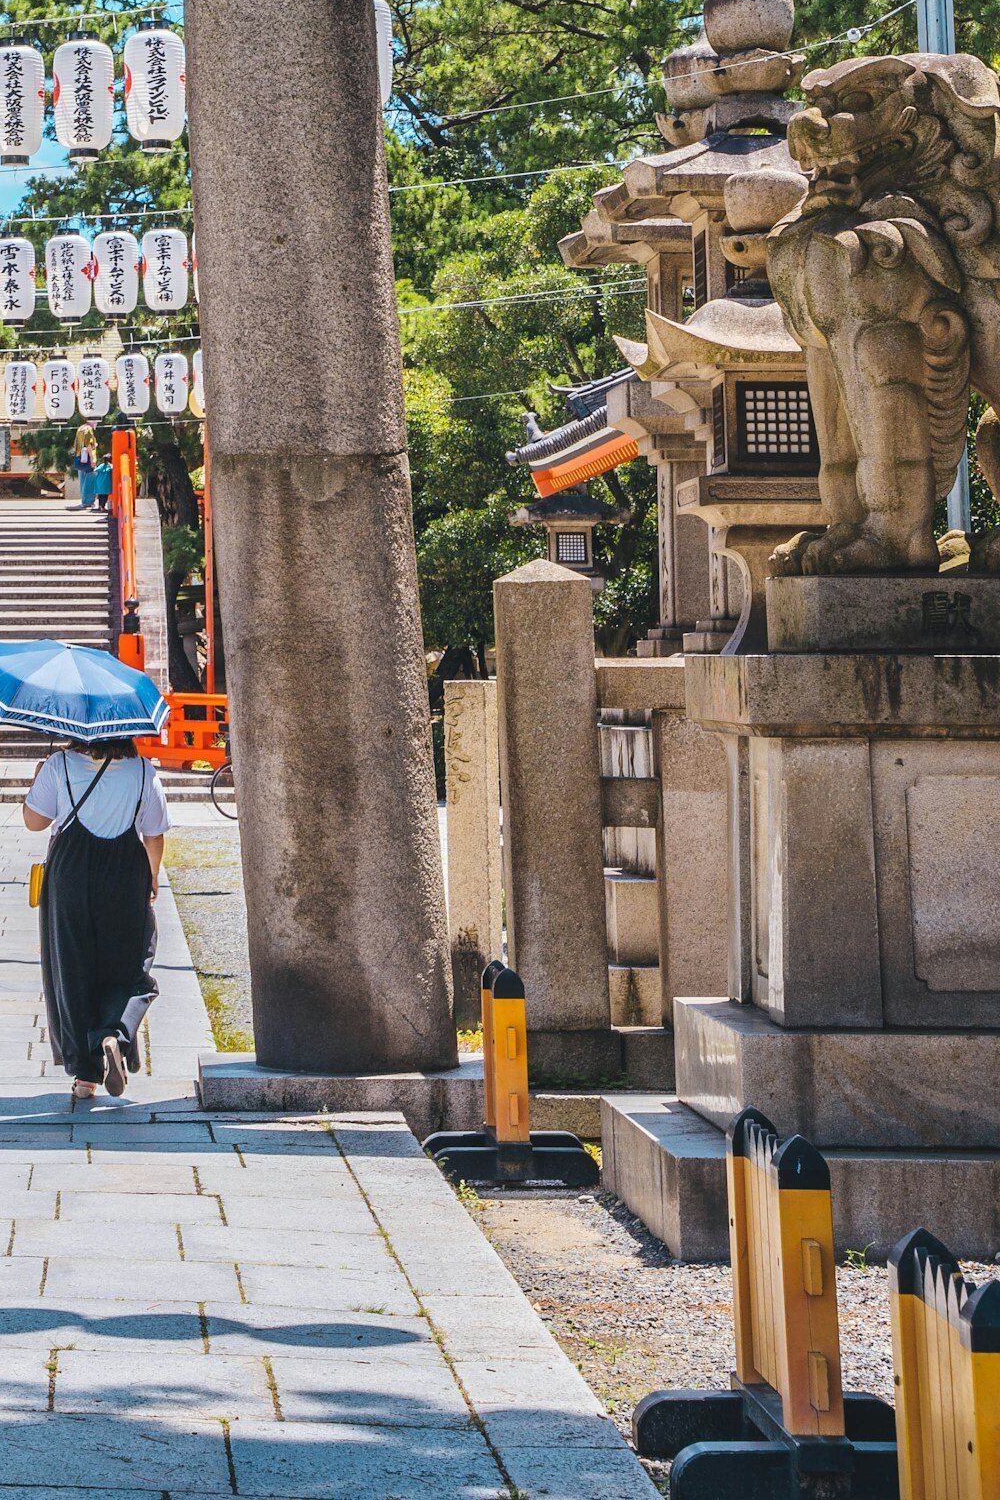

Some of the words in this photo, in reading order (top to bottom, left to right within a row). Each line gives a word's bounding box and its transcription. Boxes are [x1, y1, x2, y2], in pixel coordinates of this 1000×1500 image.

[3, 51, 26, 147] 株式会社大阪農林会館
[73, 46, 95, 143] 株式会社大阪農林会館
[144, 37, 171, 125] 株式会社ラインビルド
[0, 243, 22, 311] 雪本泰永
